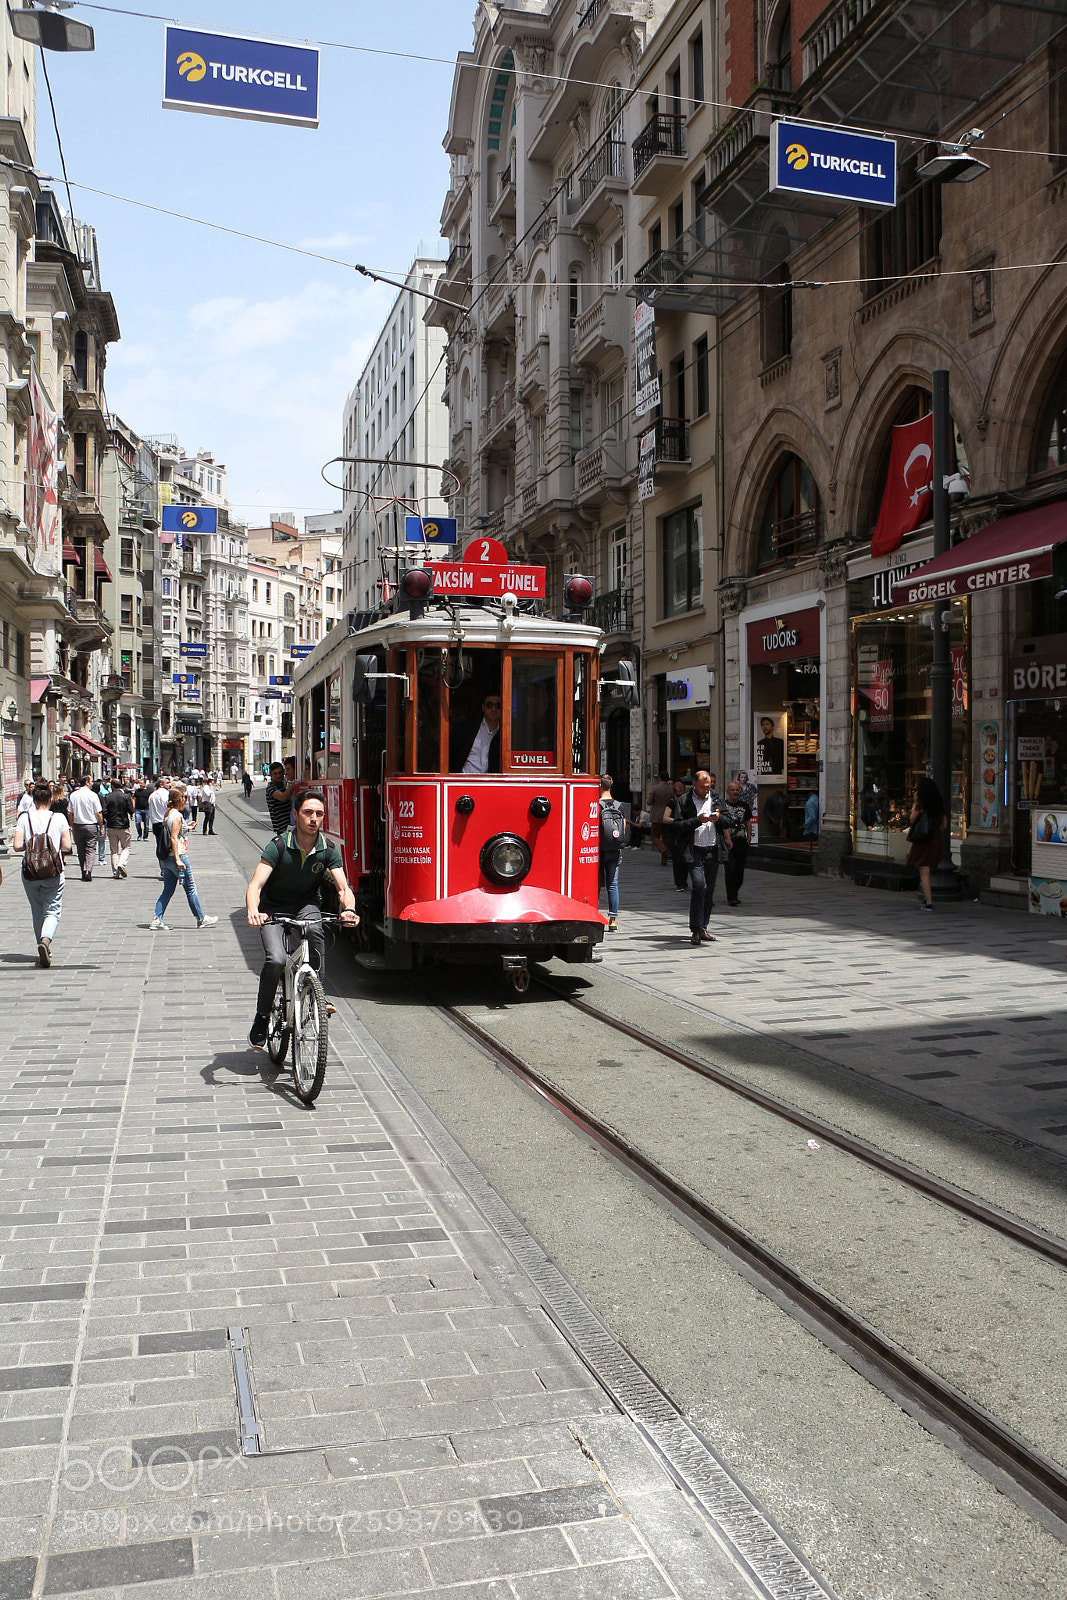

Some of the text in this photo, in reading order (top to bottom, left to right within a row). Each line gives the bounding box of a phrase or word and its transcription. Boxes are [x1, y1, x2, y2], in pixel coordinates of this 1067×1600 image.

[209, 62, 307, 91] TURKCELL
[811, 152, 886, 178] TURKCELL
[480, 541, 490, 561] 2
[499, 569, 538, 591] TÜNEL
[908, 563, 1030, 603] BÖREK CENTER
[762, 630, 797, 651] TUDORS
[874, 688, 889, 710] 50
[871, 714, 892, 723] DISCOUNT
[513, 753, 549, 764] TÜNEL
[399, 801, 414, 818] 223
